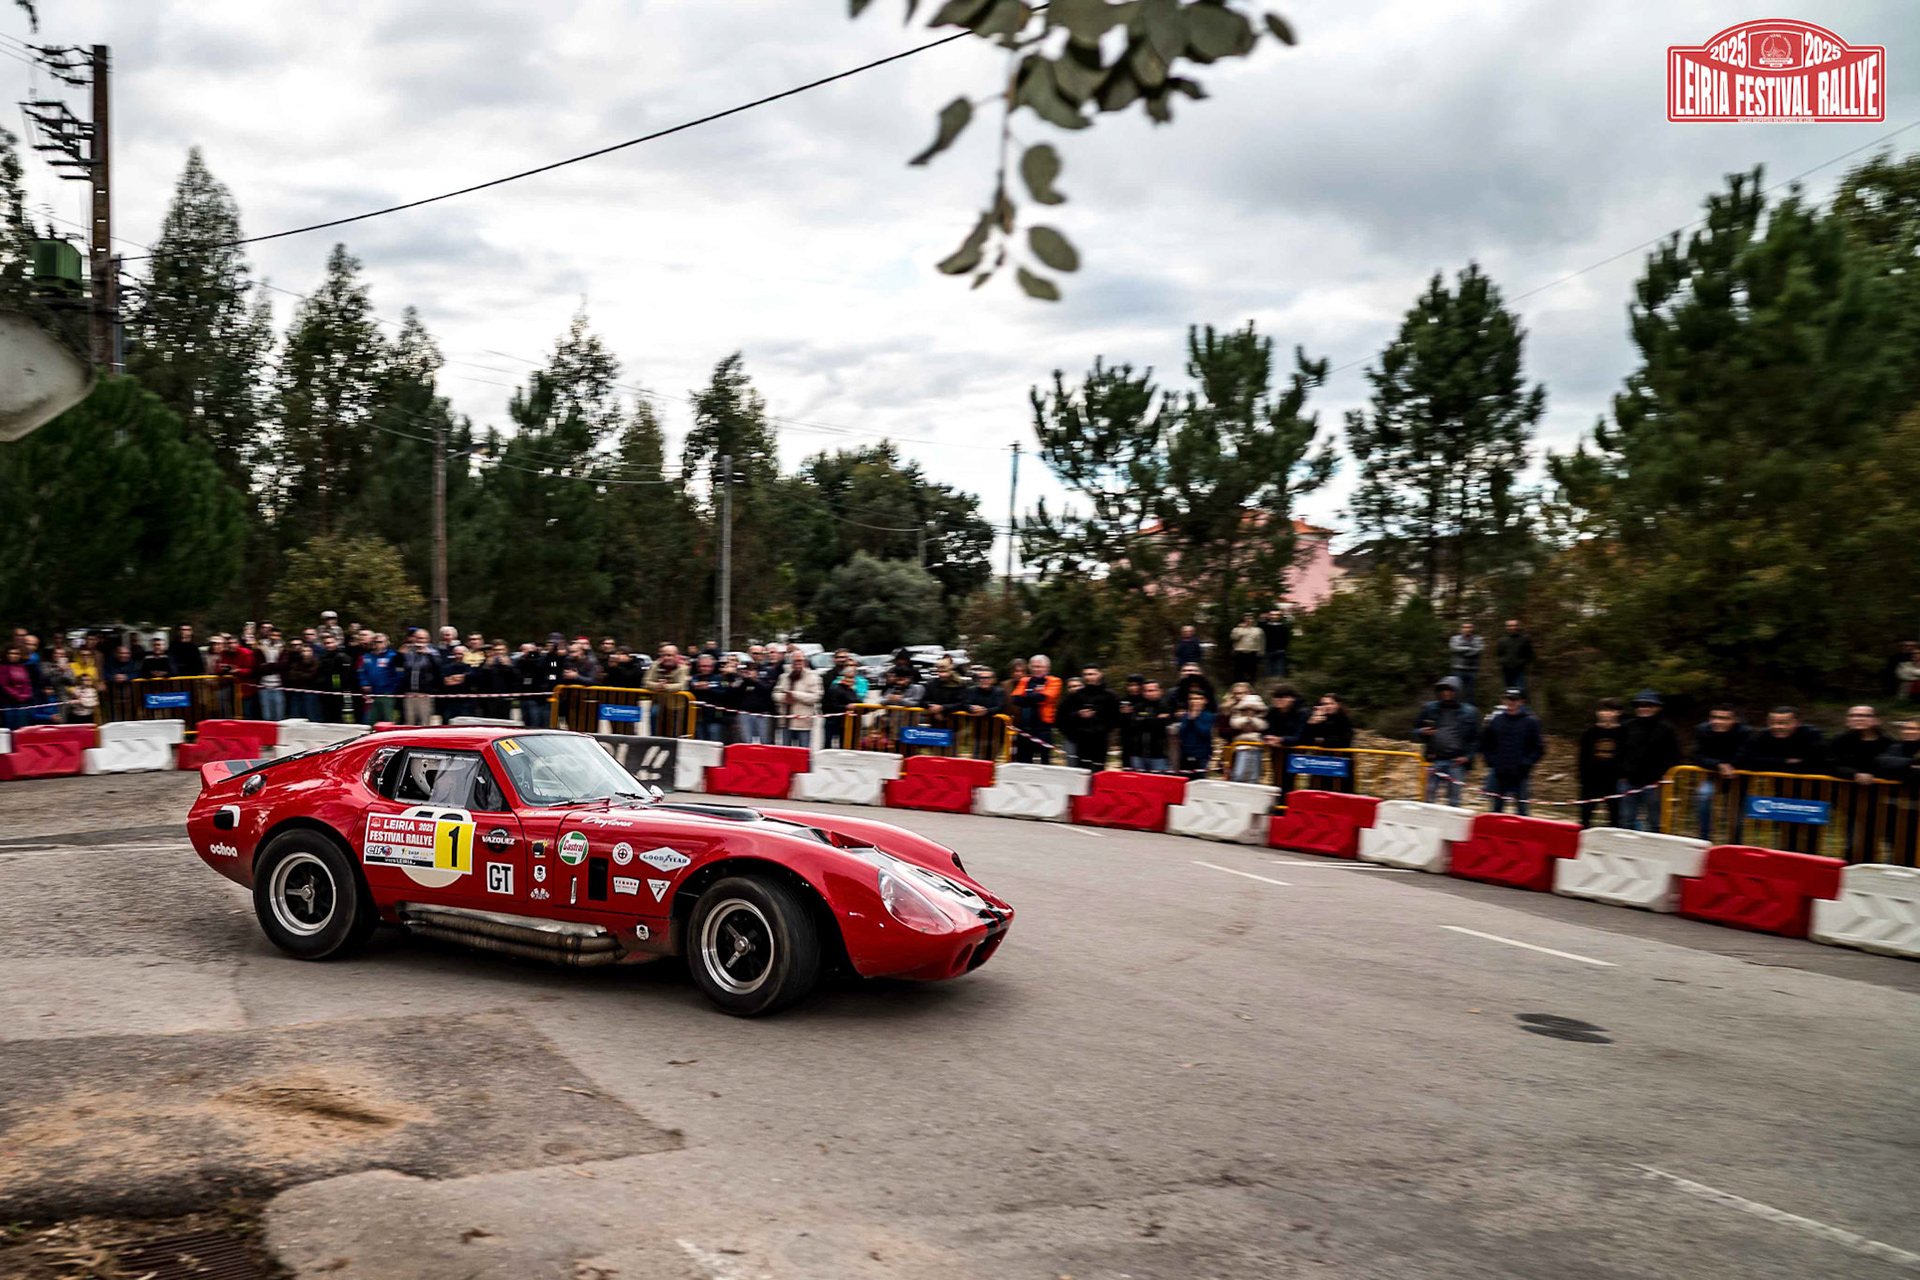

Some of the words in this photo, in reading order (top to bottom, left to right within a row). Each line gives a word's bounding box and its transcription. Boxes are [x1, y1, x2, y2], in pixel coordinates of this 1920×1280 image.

[383, 819, 415, 831] LEIRIA
[418, 822, 434, 832] 2025
[369, 830, 405, 843] FESTIVAL
[405, 833, 433, 846] RALLYE
[481, 835, 516, 846] VAZQUEZ
[210, 842, 238, 857] ochoa
[366, 845, 384, 855] elf
[448, 825, 460, 867] 1
[563, 840, 586, 852] Castrol
[489, 864, 511, 892] GT
